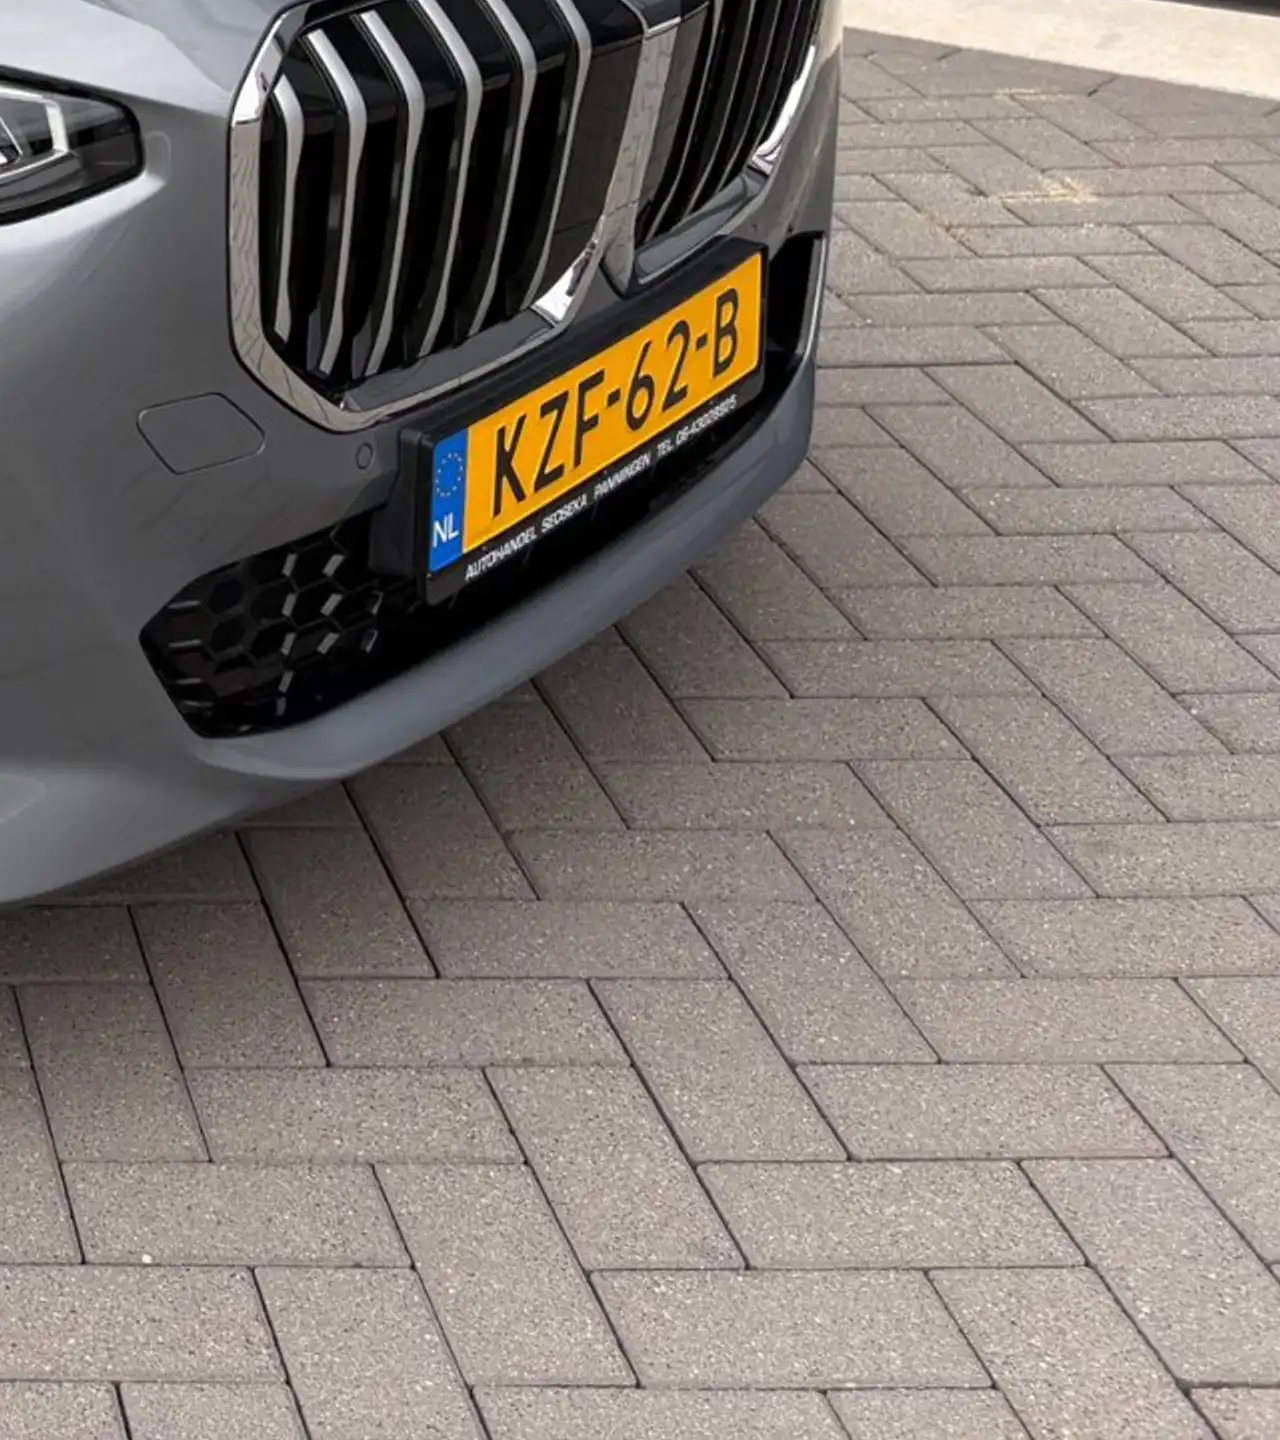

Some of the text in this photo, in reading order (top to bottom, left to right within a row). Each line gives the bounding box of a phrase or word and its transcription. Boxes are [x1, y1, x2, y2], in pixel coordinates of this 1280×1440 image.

[491, 287, 739, 519] KZF-62-B
[431, 512, 460, 549] NL
[465, 526, 537, 581] AUTOHANDEL
